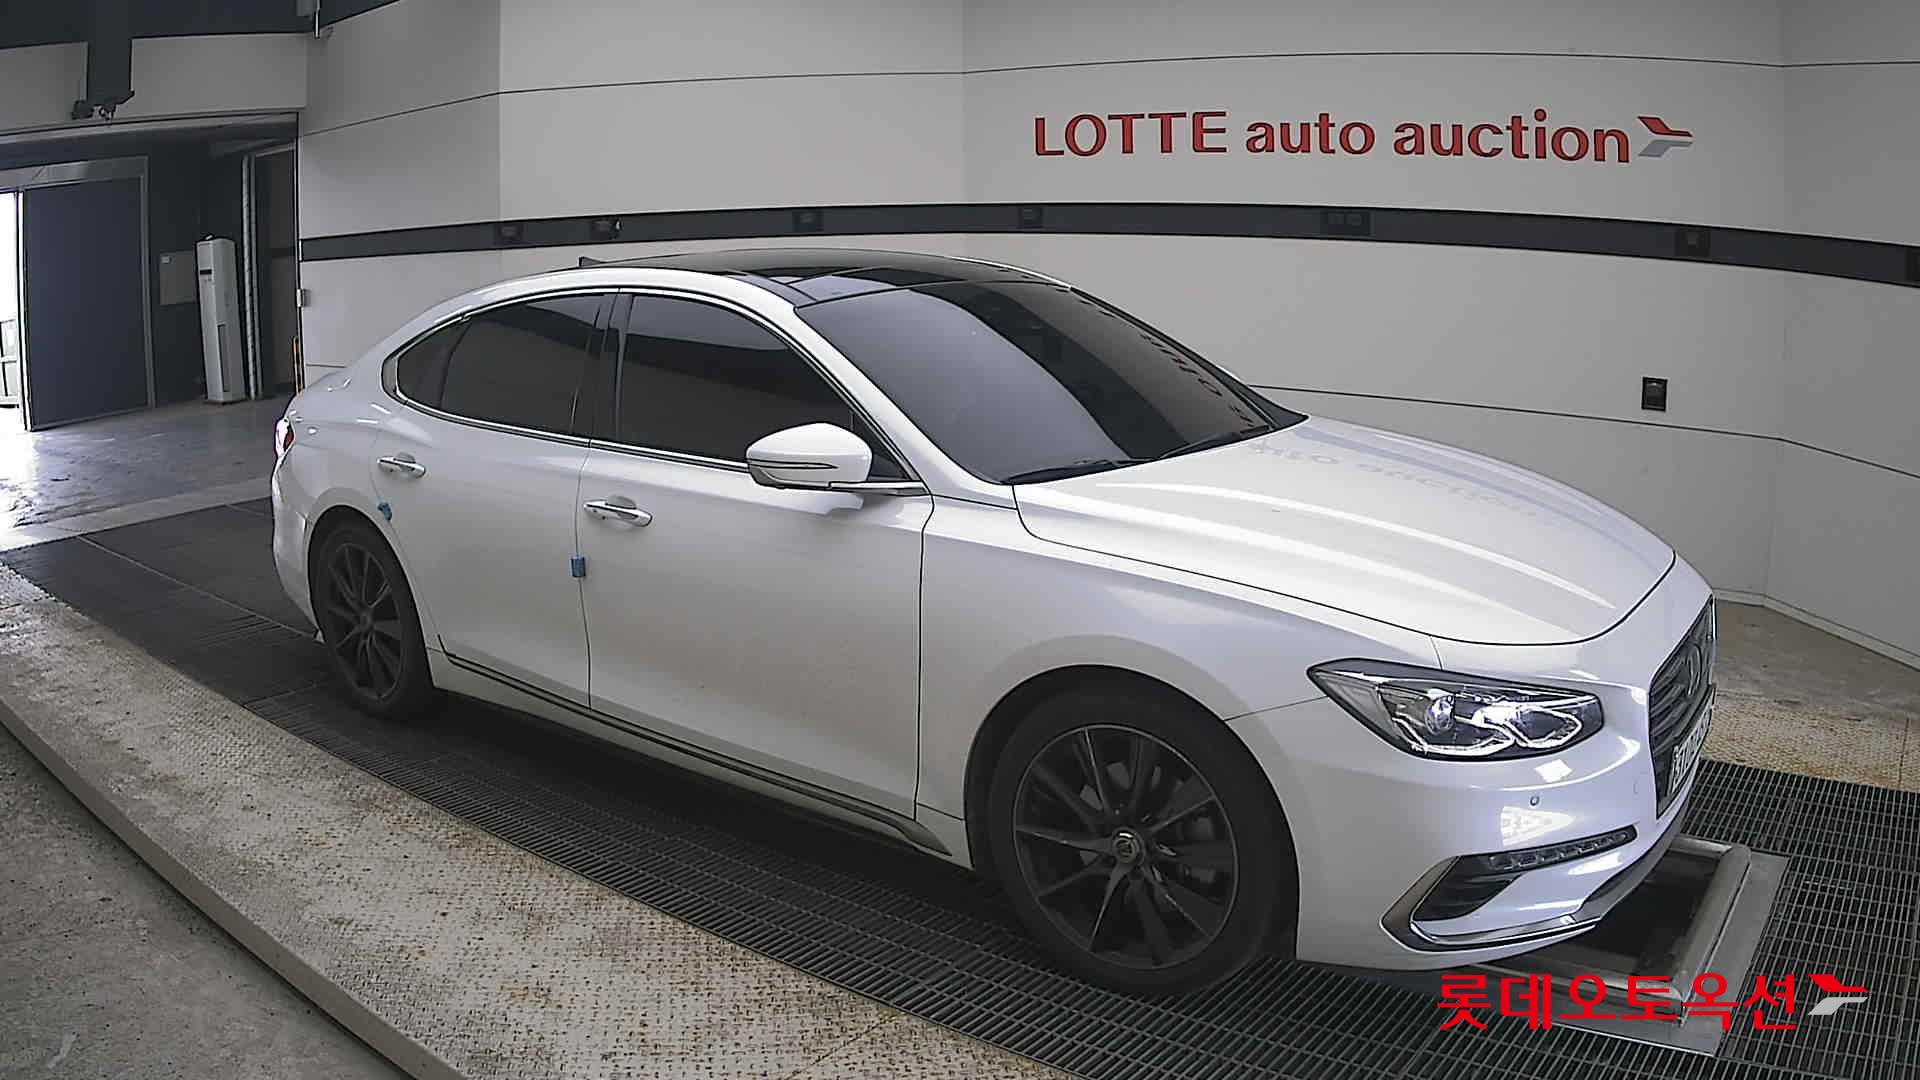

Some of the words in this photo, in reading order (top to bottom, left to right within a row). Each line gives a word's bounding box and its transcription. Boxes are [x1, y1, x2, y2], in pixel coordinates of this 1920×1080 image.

[1034, 111, 1228, 156] LOTTE
[1245, 112, 1376, 156] auto
[1392, 107, 1631, 163] auction
